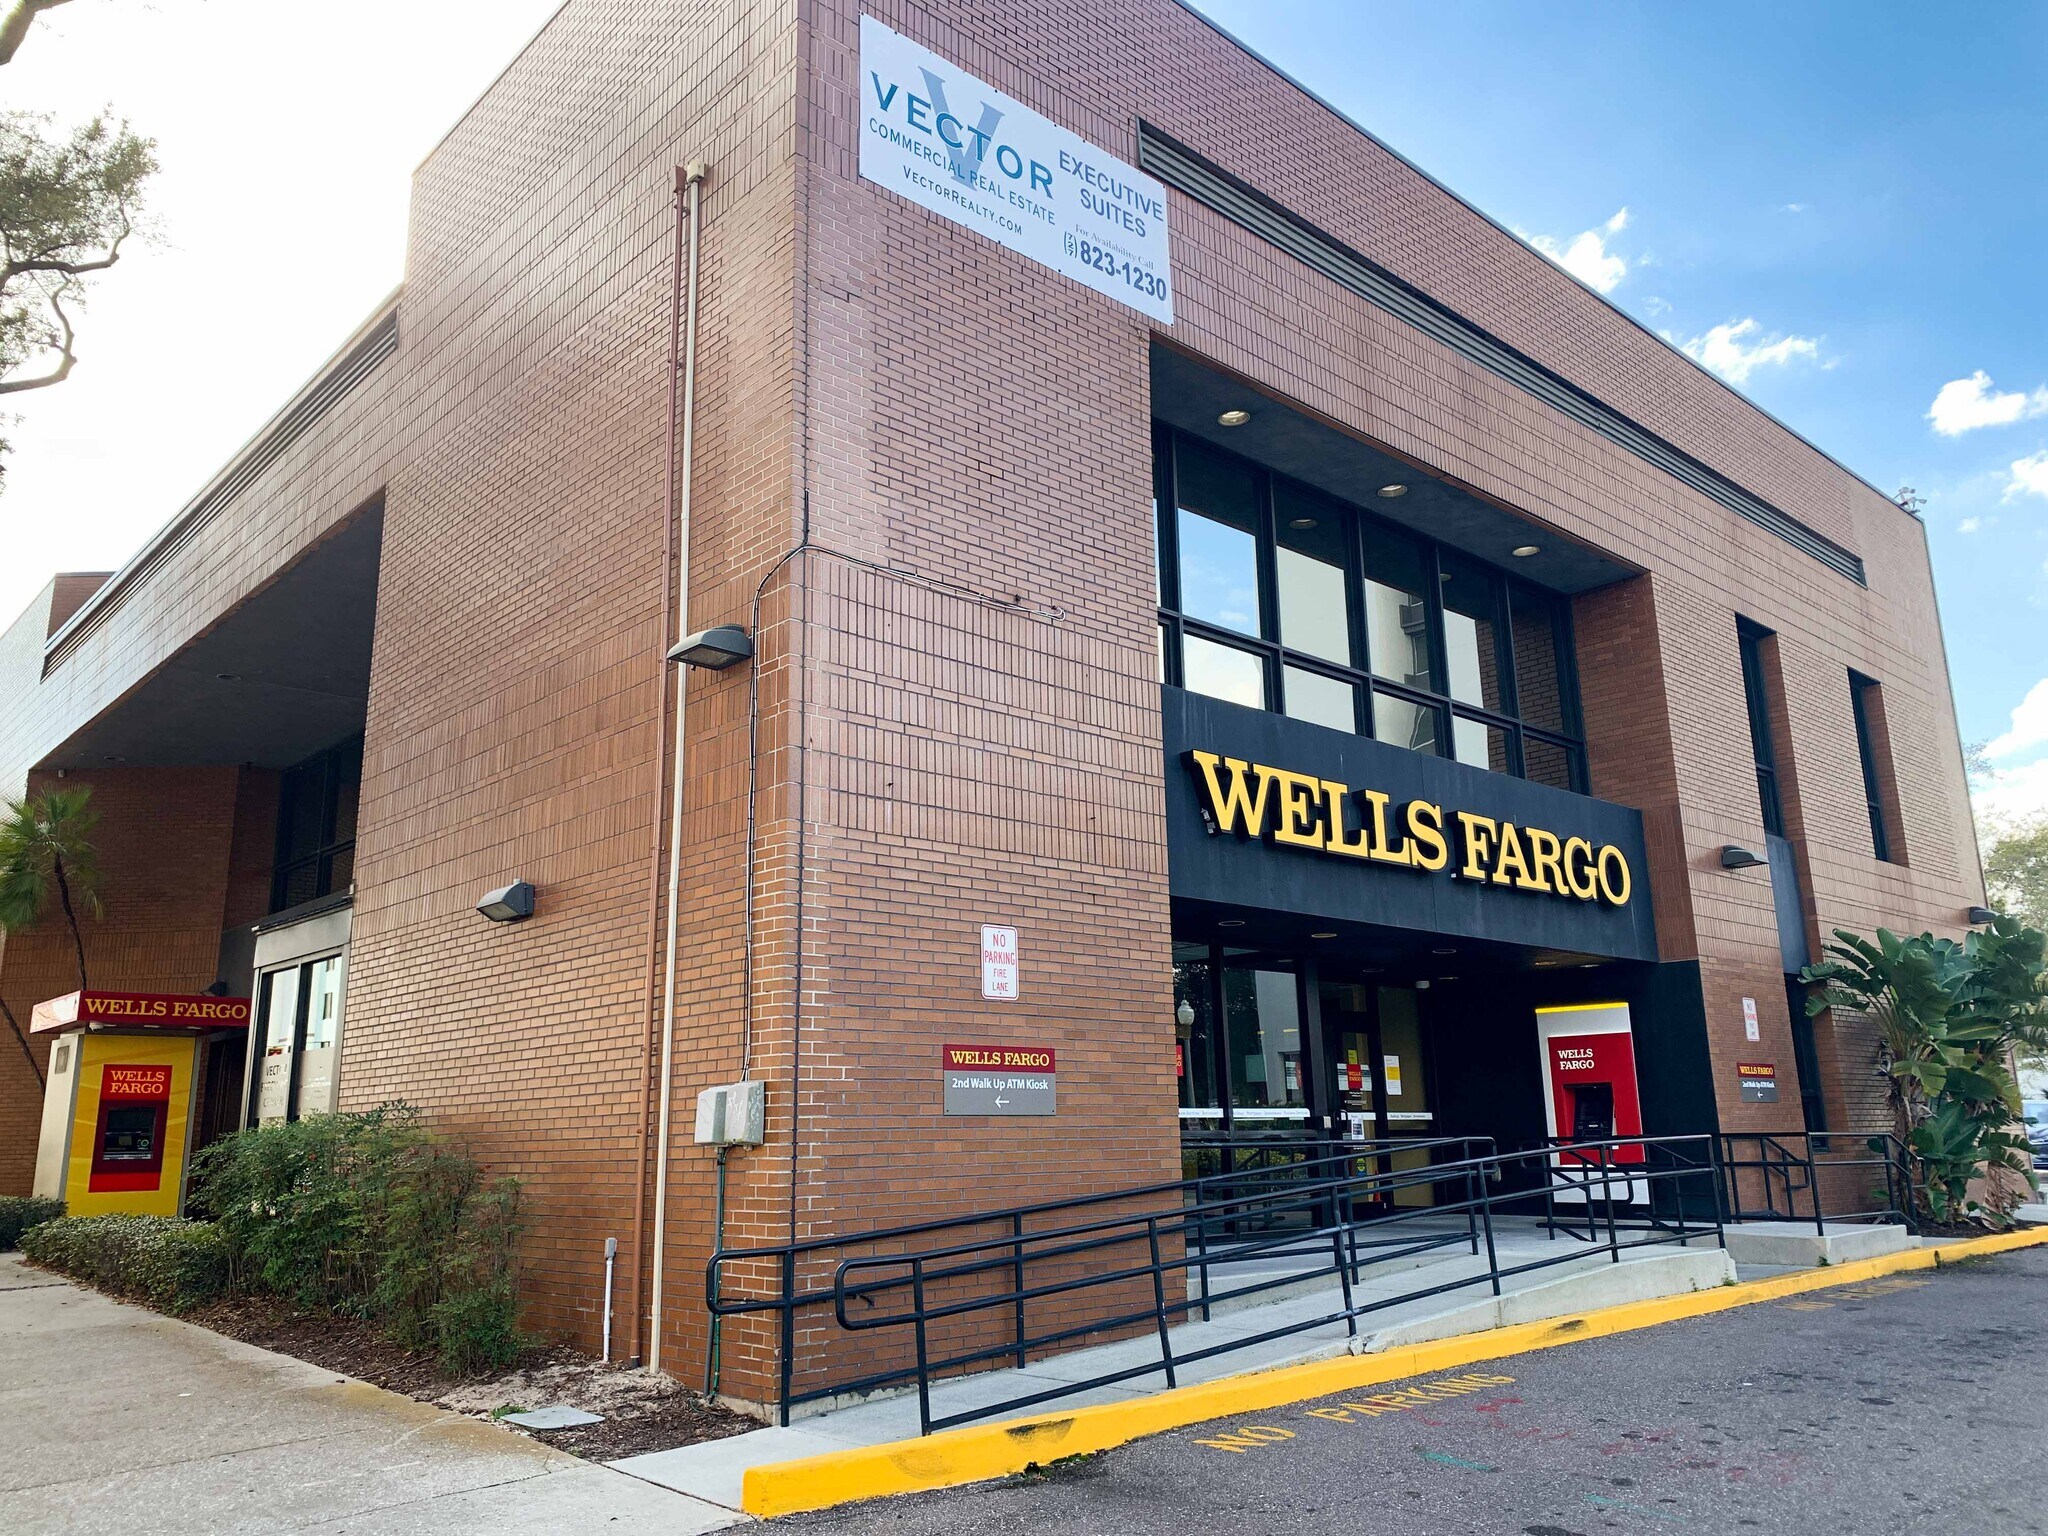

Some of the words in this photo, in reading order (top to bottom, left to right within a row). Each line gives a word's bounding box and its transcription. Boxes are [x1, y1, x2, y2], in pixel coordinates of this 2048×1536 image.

[870, 70, 1054, 200] VECTOR
[869, 117, 965, 180] COMMERCIAL
[970, 170, 1005, 200] REAL
[1009, 192, 1056, 225] ESTATE
[1059, 149, 1164, 222] EXECUTIVE
[1080, 188, 1146, 238] SUITES
[1075, 224, 1090, 237] For
[1091, 232, 1137, 262] Availability
[1138, 256, 1154, 270] Call
[1080, 240, 1167, 301] 823-1230
[1192, 749, 1449, 872] WELLS
[1457, 810, 1632, 907] FARGO
[992, 934, 1006, 948] NO
[984, 951, 1016, 966] PARKING
[993, 968, 1007, 979] FIRE
[992, 982, 1009, 992] LANE
[85, 998, 167, 1016] WELLS
[173, 1002, 248, 1020] FARGO
[950, 1051, 1001, 1065] WELLS
[1003, 1052, 1050, 1067] FARGO
[1558, 1048, 1594, 1059] WELLS
[1560, 1059, 1595, 1070] FARGO
[1740, 1066, 1757, 1075] WELLS
[1758, 1066, 1774, 1076] FARGO
[111, 1070, 165, 1083] WELLS
[952, 1077, 969, 1089] 2nd
[970, 1078, 992, 1089] Walk
[992, 1079, 1005, 1091] Up
[1006, 1079, 1026, 1090] ATM
[1026, 1078, 1049, 1090] Kiosk
[110, 1082, 163, 1094] FARGO
[1304, 1373, 1516, 1423] PARKING
[1192, 1426, 1296, 1453] NO
